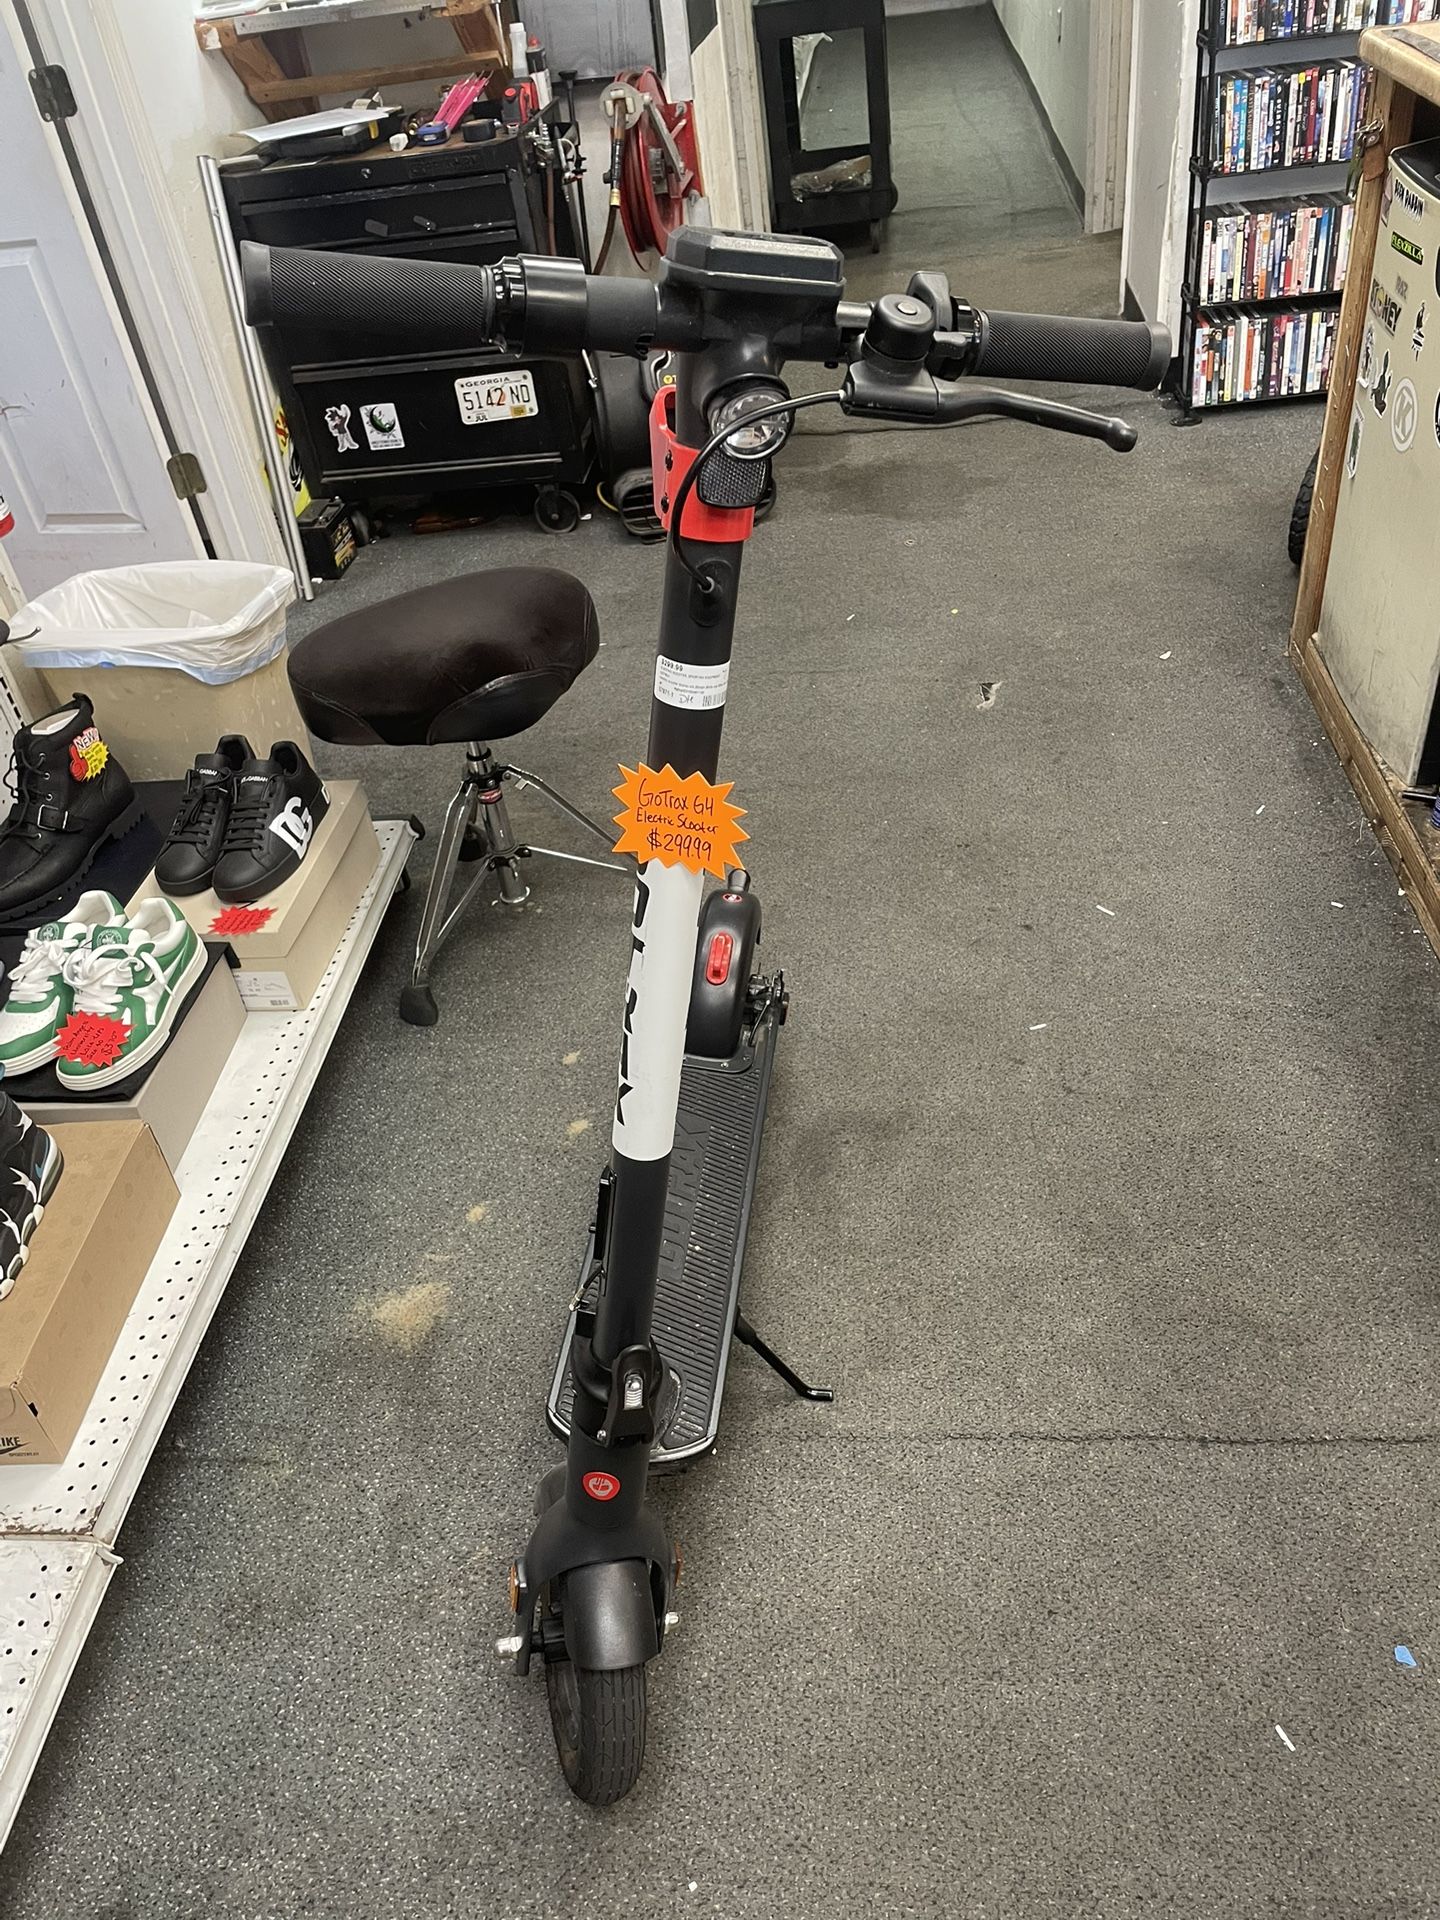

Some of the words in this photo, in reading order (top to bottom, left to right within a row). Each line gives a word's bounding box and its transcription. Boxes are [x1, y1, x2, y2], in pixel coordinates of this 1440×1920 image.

[465, 376, 510, 388] GEORGIA
[636, 806, 675, 827] Electric
[676, 813, 719, 835] Scooter
[646, 827, 712, 861] $299.99
[0, 1436, 20, 1447] IKE
